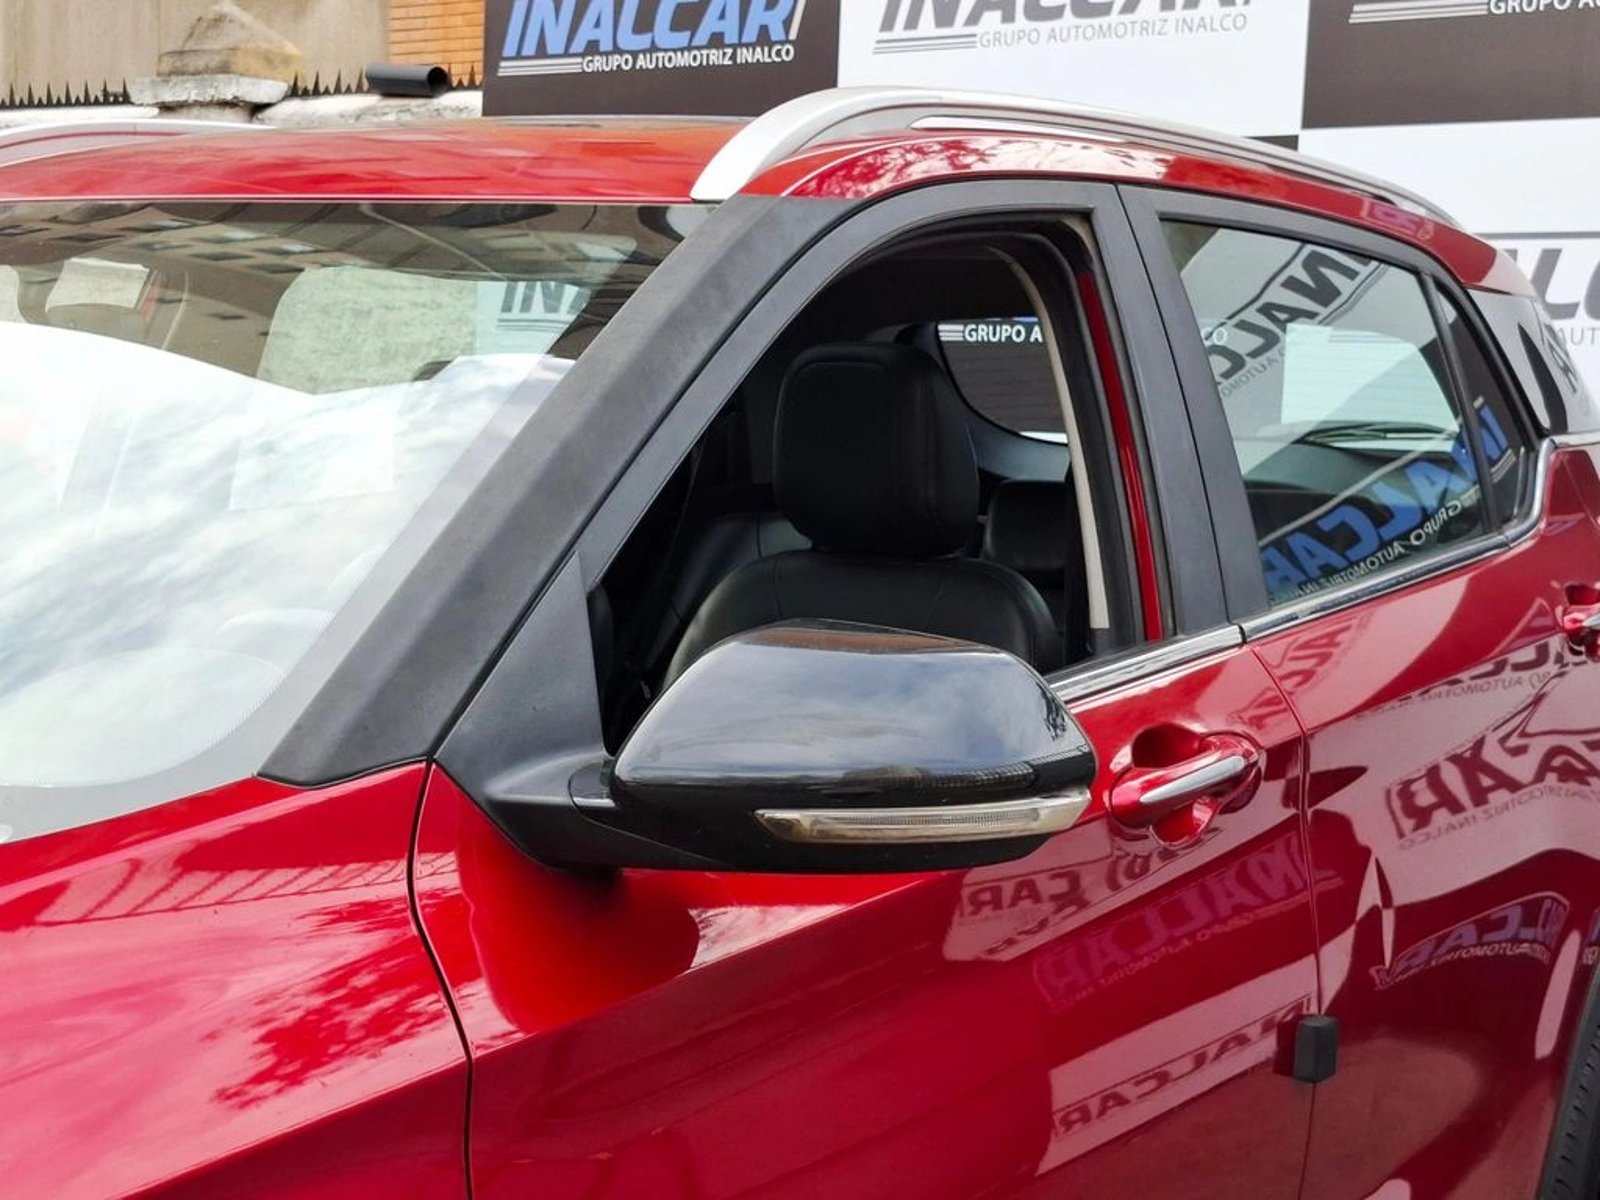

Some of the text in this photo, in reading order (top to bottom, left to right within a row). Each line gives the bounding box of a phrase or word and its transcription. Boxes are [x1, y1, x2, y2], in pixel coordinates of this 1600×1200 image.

[979, 28, 1040, 48] GRUPO
[1047, 19, 1168, 43] AUTOMOTRIZ
[1174, 13, 1248, 34] INALCO
[583, 44, 795, 72] GRUPO AUTOMOTRIZ INALCO
[965, 324, 1026, 343] GRUPO
